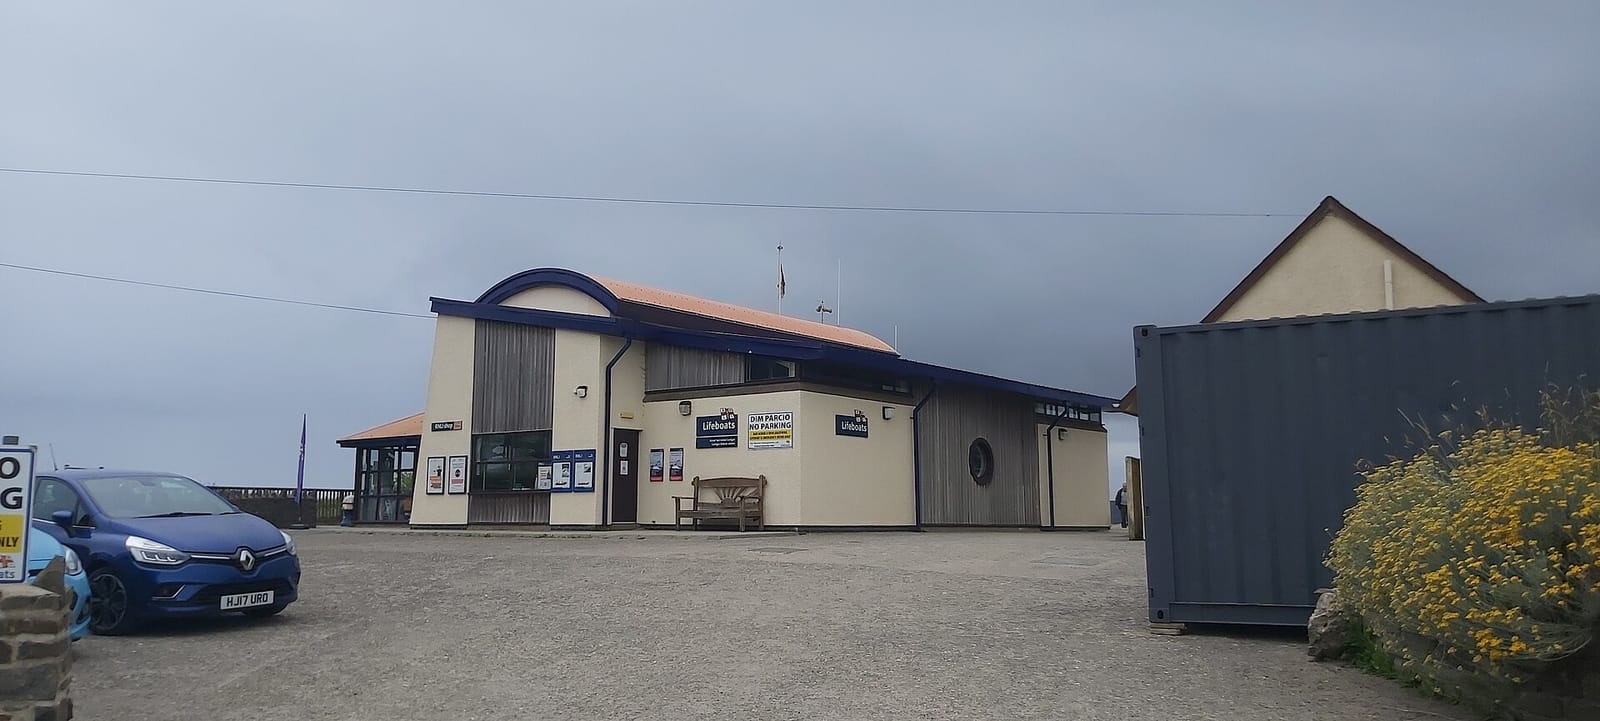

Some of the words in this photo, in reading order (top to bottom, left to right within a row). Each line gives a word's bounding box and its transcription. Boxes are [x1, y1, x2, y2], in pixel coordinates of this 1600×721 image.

[702, 420, 736, 431] Lifeboats
[761, 422, 791, 430] PARKING
[841, 420, 867, 432] Lifeboats
[0, 487, 23, 509] G
[226, 595, 249, 607] HJ17
[250, 592, 269, 604] URO
